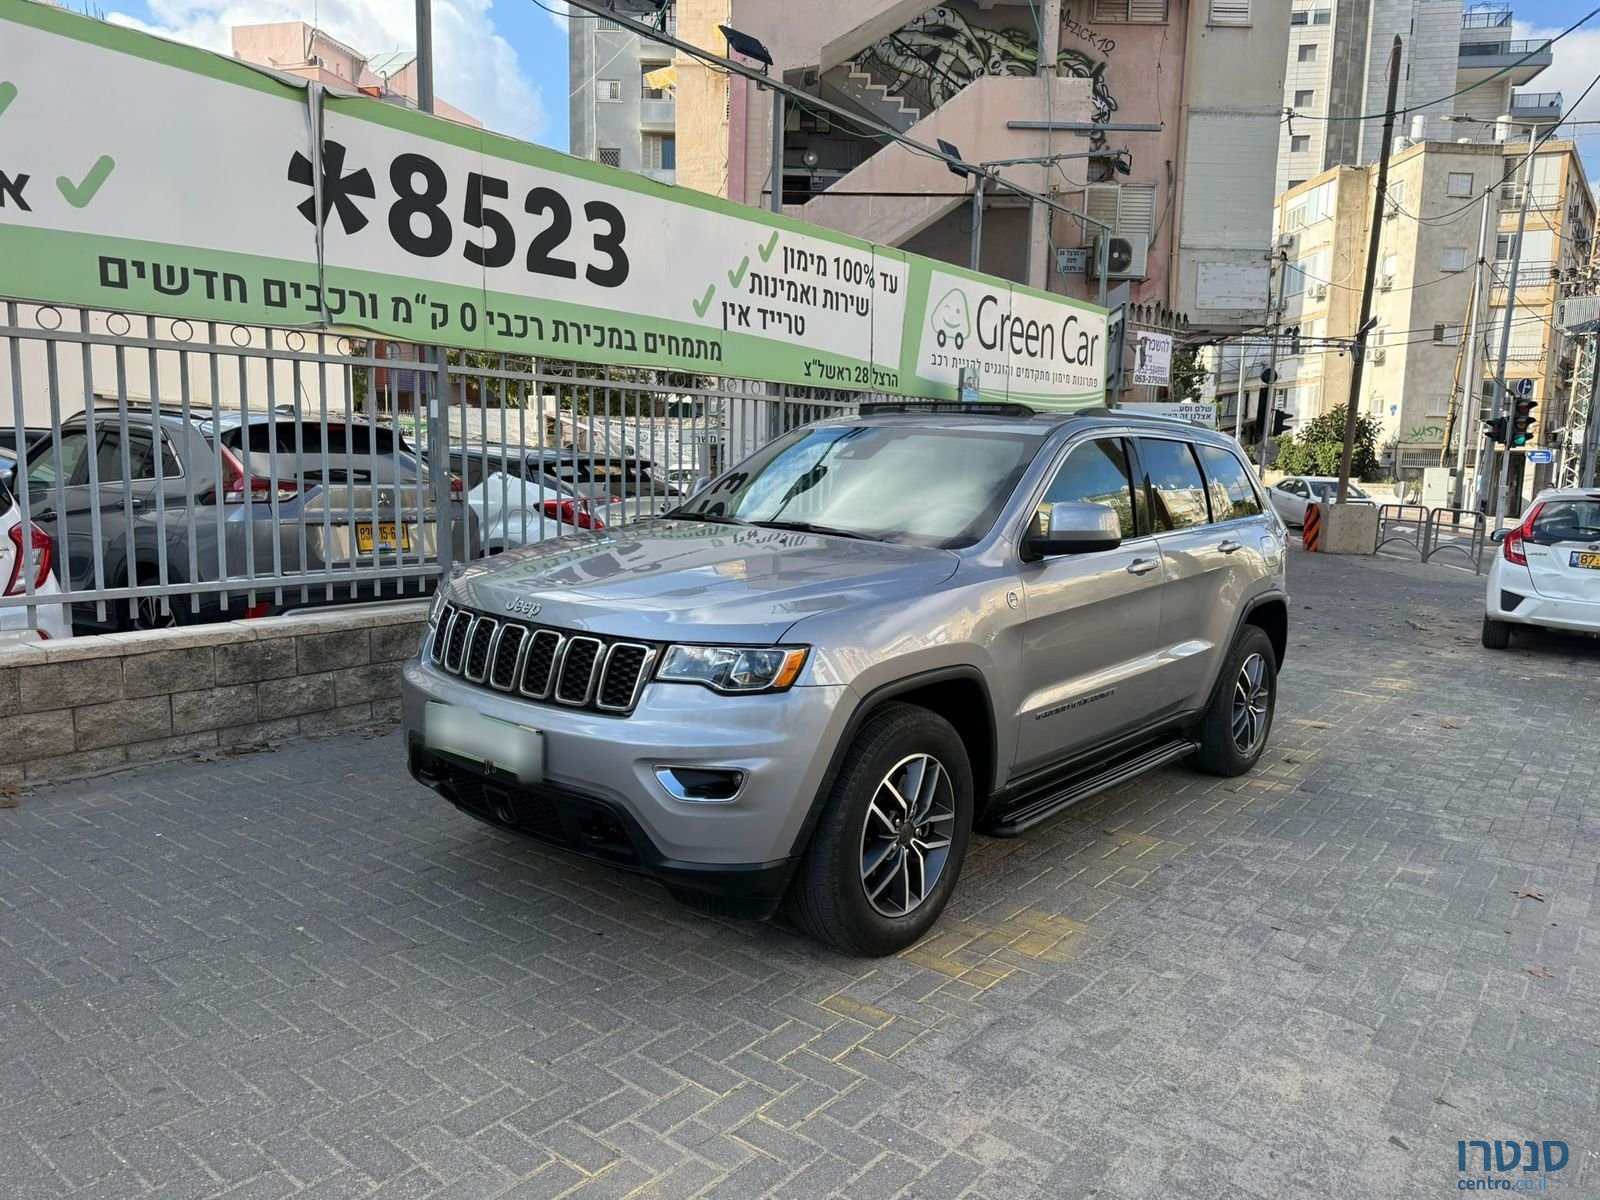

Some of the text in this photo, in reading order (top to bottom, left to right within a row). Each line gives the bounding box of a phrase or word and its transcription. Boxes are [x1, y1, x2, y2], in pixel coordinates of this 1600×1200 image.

[98, 256, 248, 303] חדשים
[783, 246, 898, 294] עד 100% מימון
[750, 272, 869, 317] שירות ואמינות
[460, 302, 477, 332] 0
[486, 311, 544, 340] רכבי
[722, 301, 805, 336] טרייד אין
[976, 294, 1099, 367] Green Car
[552, 319, 637, 351] במכירת
[644, 331, 722, 361] מתמחים
[1146, 338, 1170, 352] להשכר
[931, 353, 948, 367] רכב
[1016, 366, 1050, 382] מתקדמים
[855, 366, 869, 384] 28
[872, 368, 898, 388] הרצל
[1052, 372, 1070, 385] מימון
[1072, 375, 1098, 388] פתרונות
[505, 596, 542, 618] Jeep
